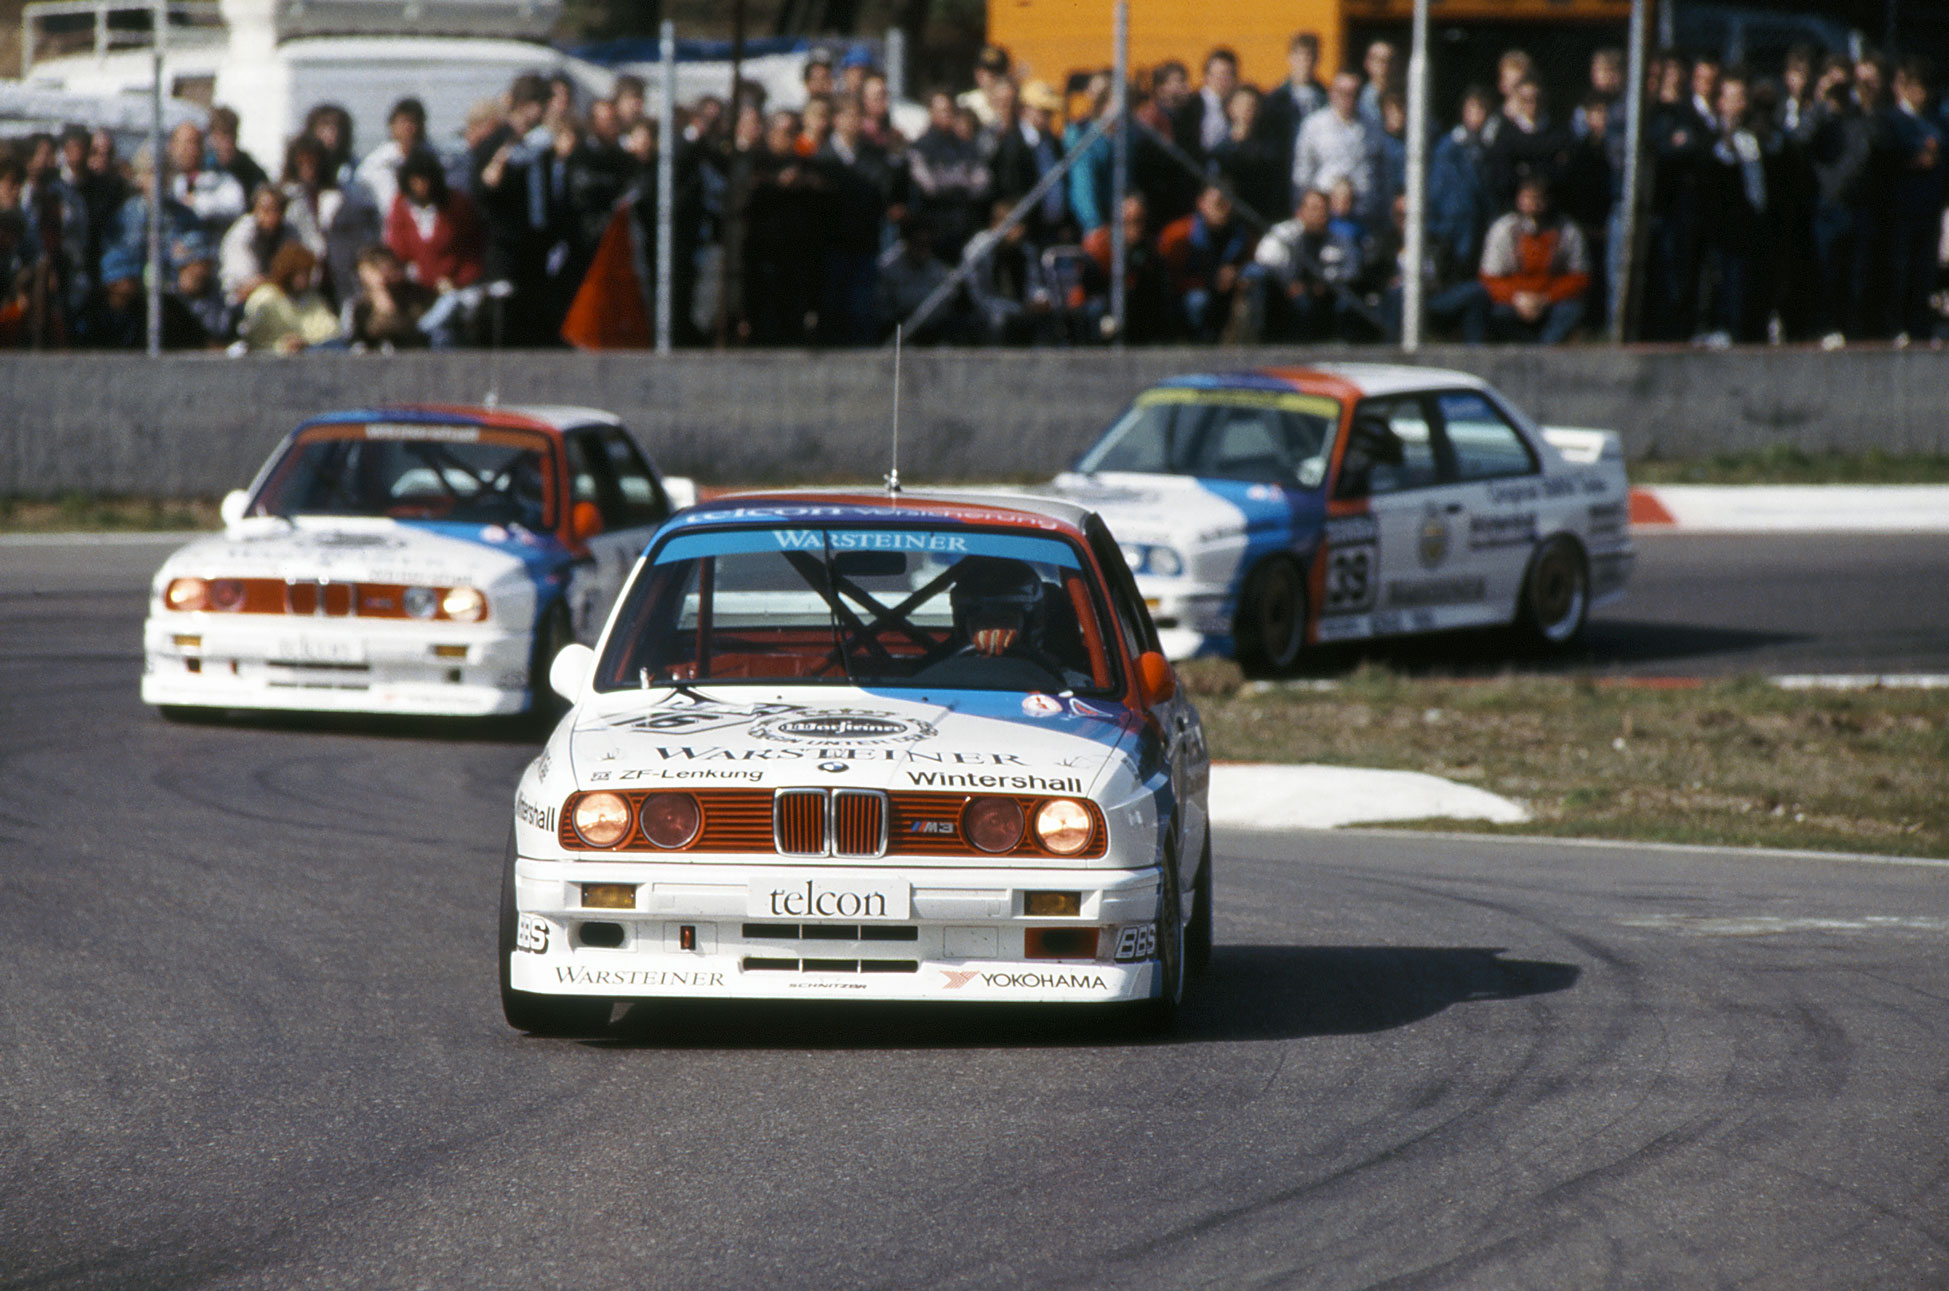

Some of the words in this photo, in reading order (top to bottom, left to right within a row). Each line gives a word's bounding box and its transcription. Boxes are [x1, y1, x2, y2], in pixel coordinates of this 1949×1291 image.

[772, 529, 967, 552] WARSTEINER
[656, 747, 1032, 766] WARSTEINER
[619, 767, 763, 783] ZF-Lenkung
[907, 771, 1082, 793] Wintershall
[923, 820, 954, 834] M3
[770, 879, 888, 917] telcon
[1114, 922, 1156, 964] BBS
[555, 965, 726, 987] WARSTEINER
[980, 972, 1108, 990] YOKOHAMA
